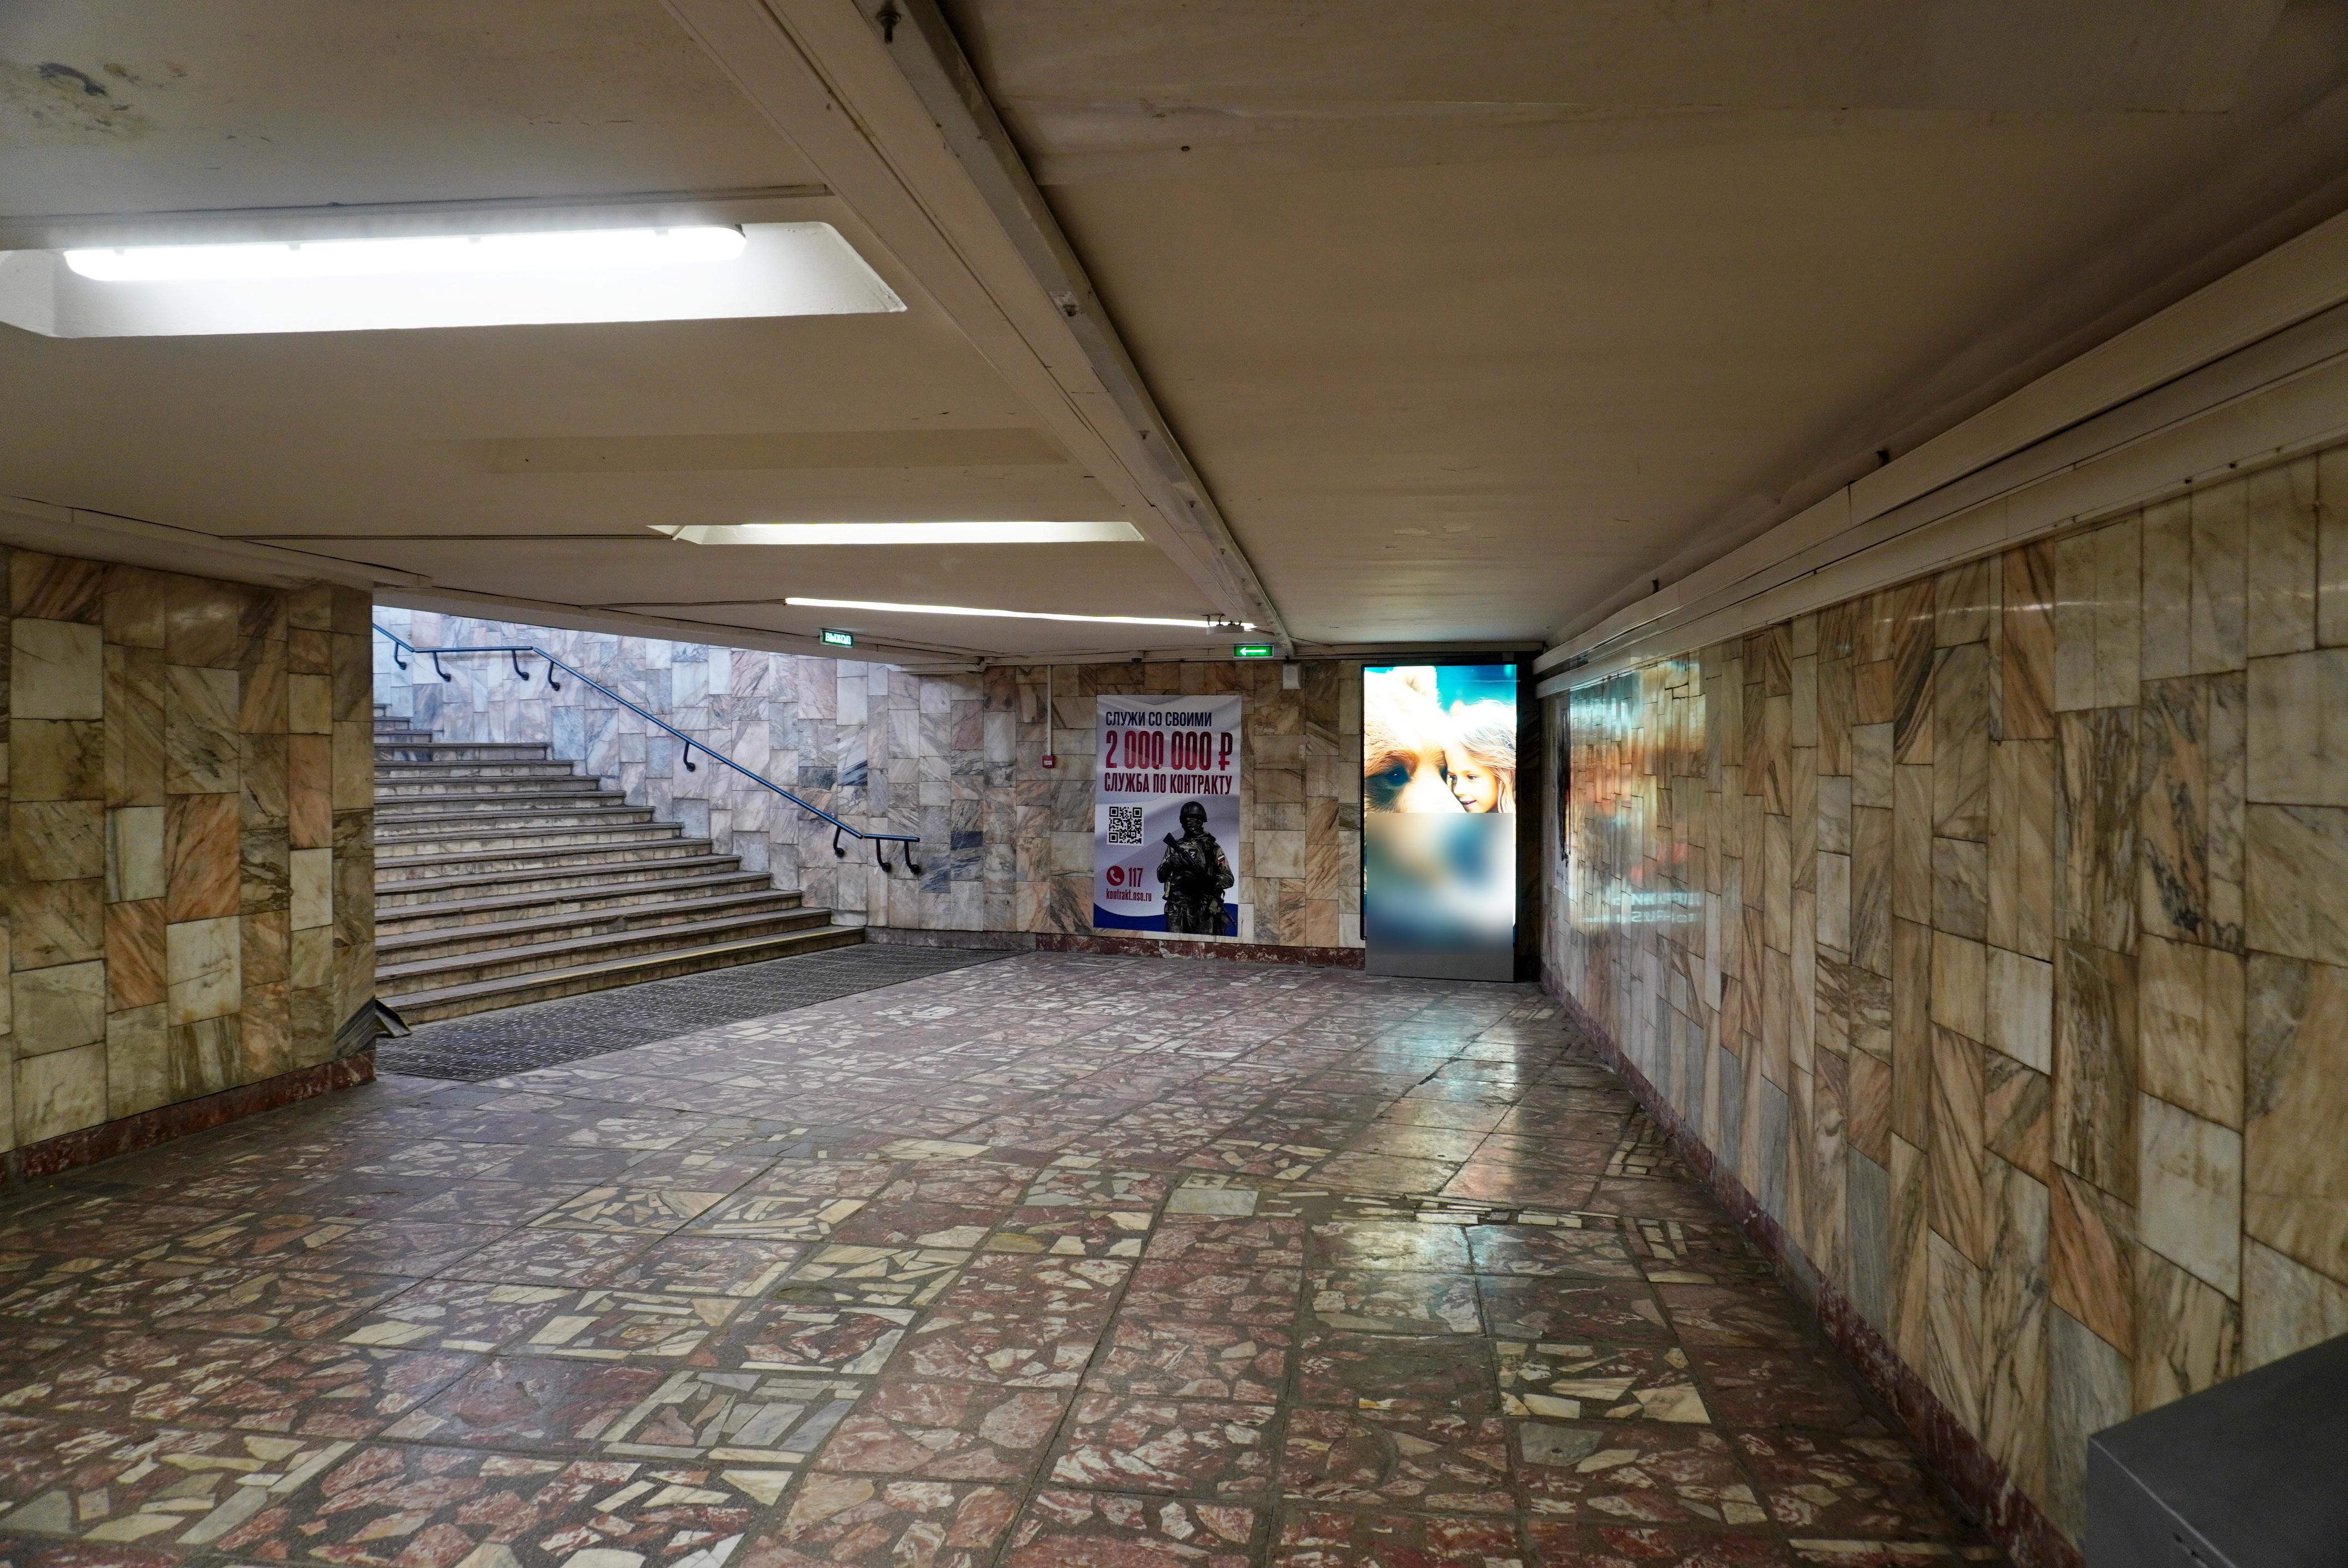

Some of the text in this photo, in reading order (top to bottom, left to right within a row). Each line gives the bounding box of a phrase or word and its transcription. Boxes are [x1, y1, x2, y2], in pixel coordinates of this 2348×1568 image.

[825, 632, 852, 645] ВЫХОД
[1105, 711, 1212, 726] СЛУЖИ СО СВОИМИ
[1105, 730, 1118, 768] 2
[1124, 730, 1164, 770] 000
[1171, 731, 1212, 771] 000
[1104, 772, 1233, 795] СЛУЖБА ПО КОНТРАКТУ
[1128, 867, 1143, 887] 117
[1106, 888, 1152, 902] kontrakt.nso.ru
